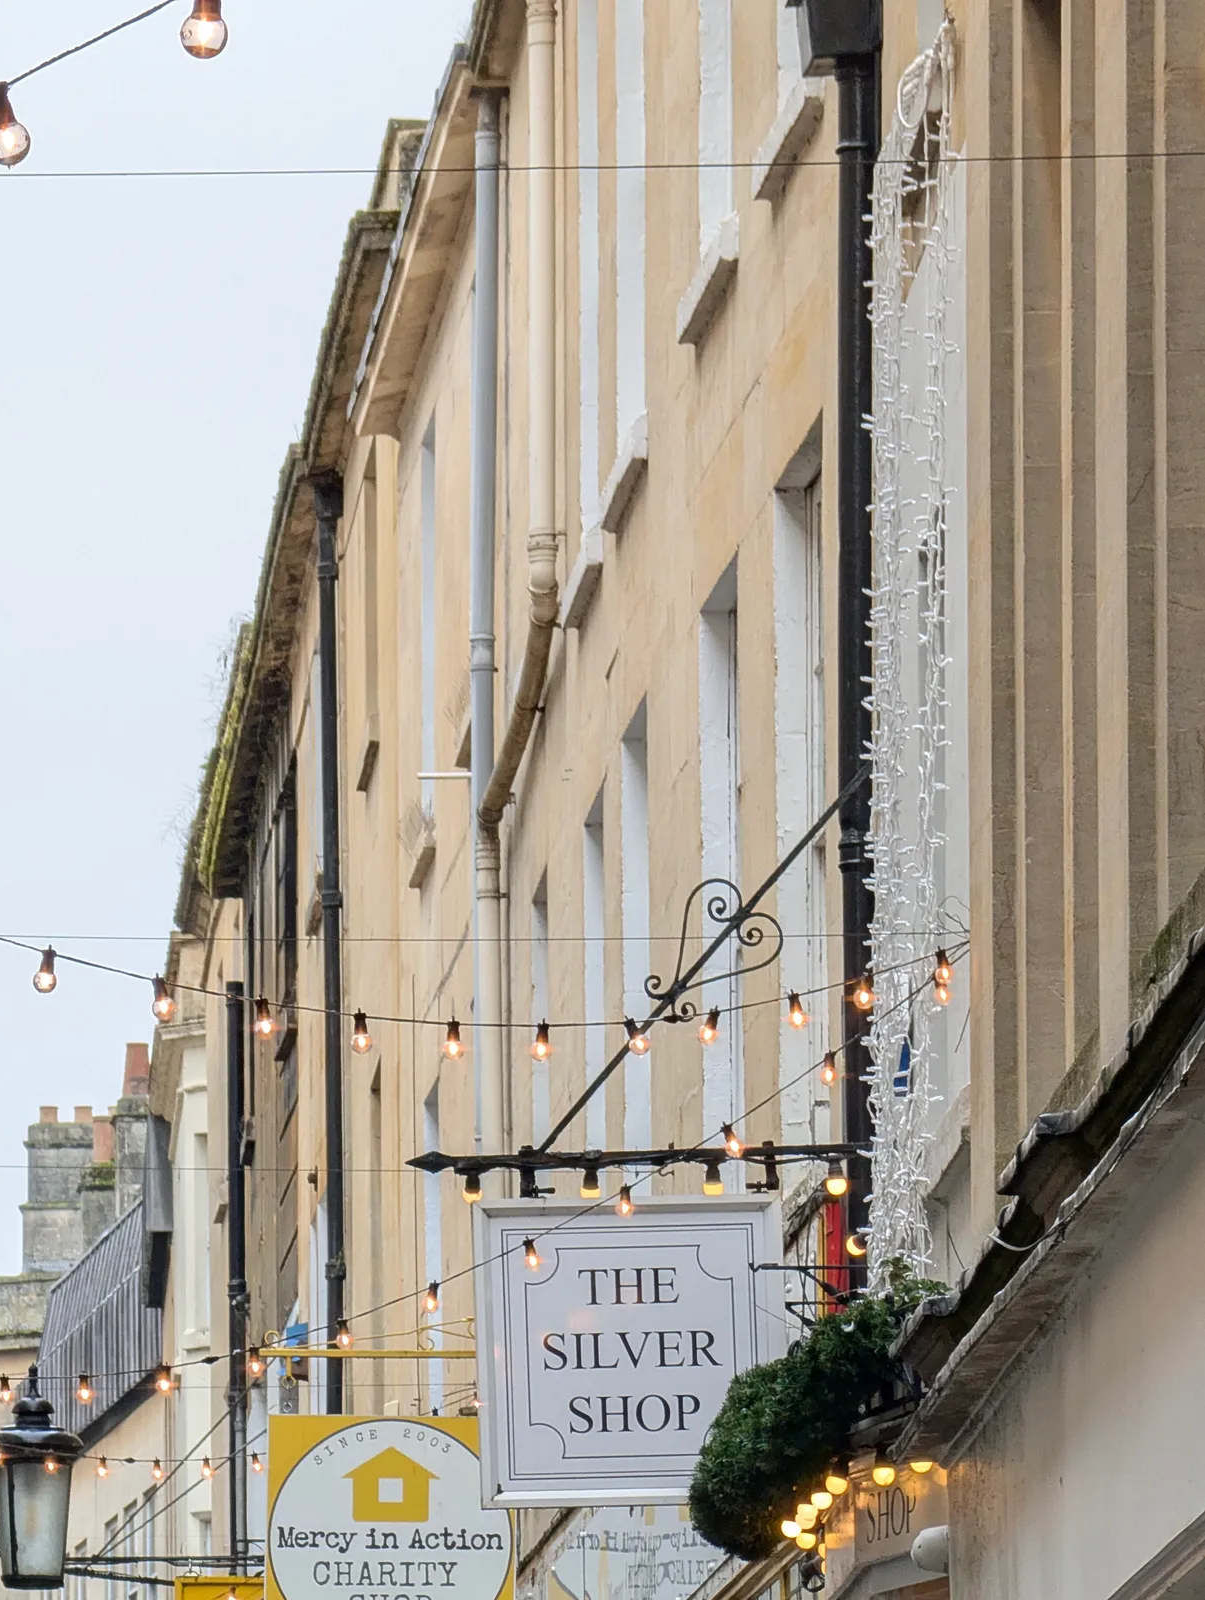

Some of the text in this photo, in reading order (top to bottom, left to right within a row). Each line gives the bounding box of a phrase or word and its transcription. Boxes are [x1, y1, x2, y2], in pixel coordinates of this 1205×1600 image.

[578, 1267, 680, 1305] THE
[543, 1330, 723, 1371] SILVER
[568, 1394, 700, 1434] SHOP
[313, 1428, 451, 1466] SINCE 2003
[866, 1486, 917, 1544] SHOP
[277, 1526, 504, 1554] Mercy in Action
[312, 1560, 458, 1588] CHARITY
